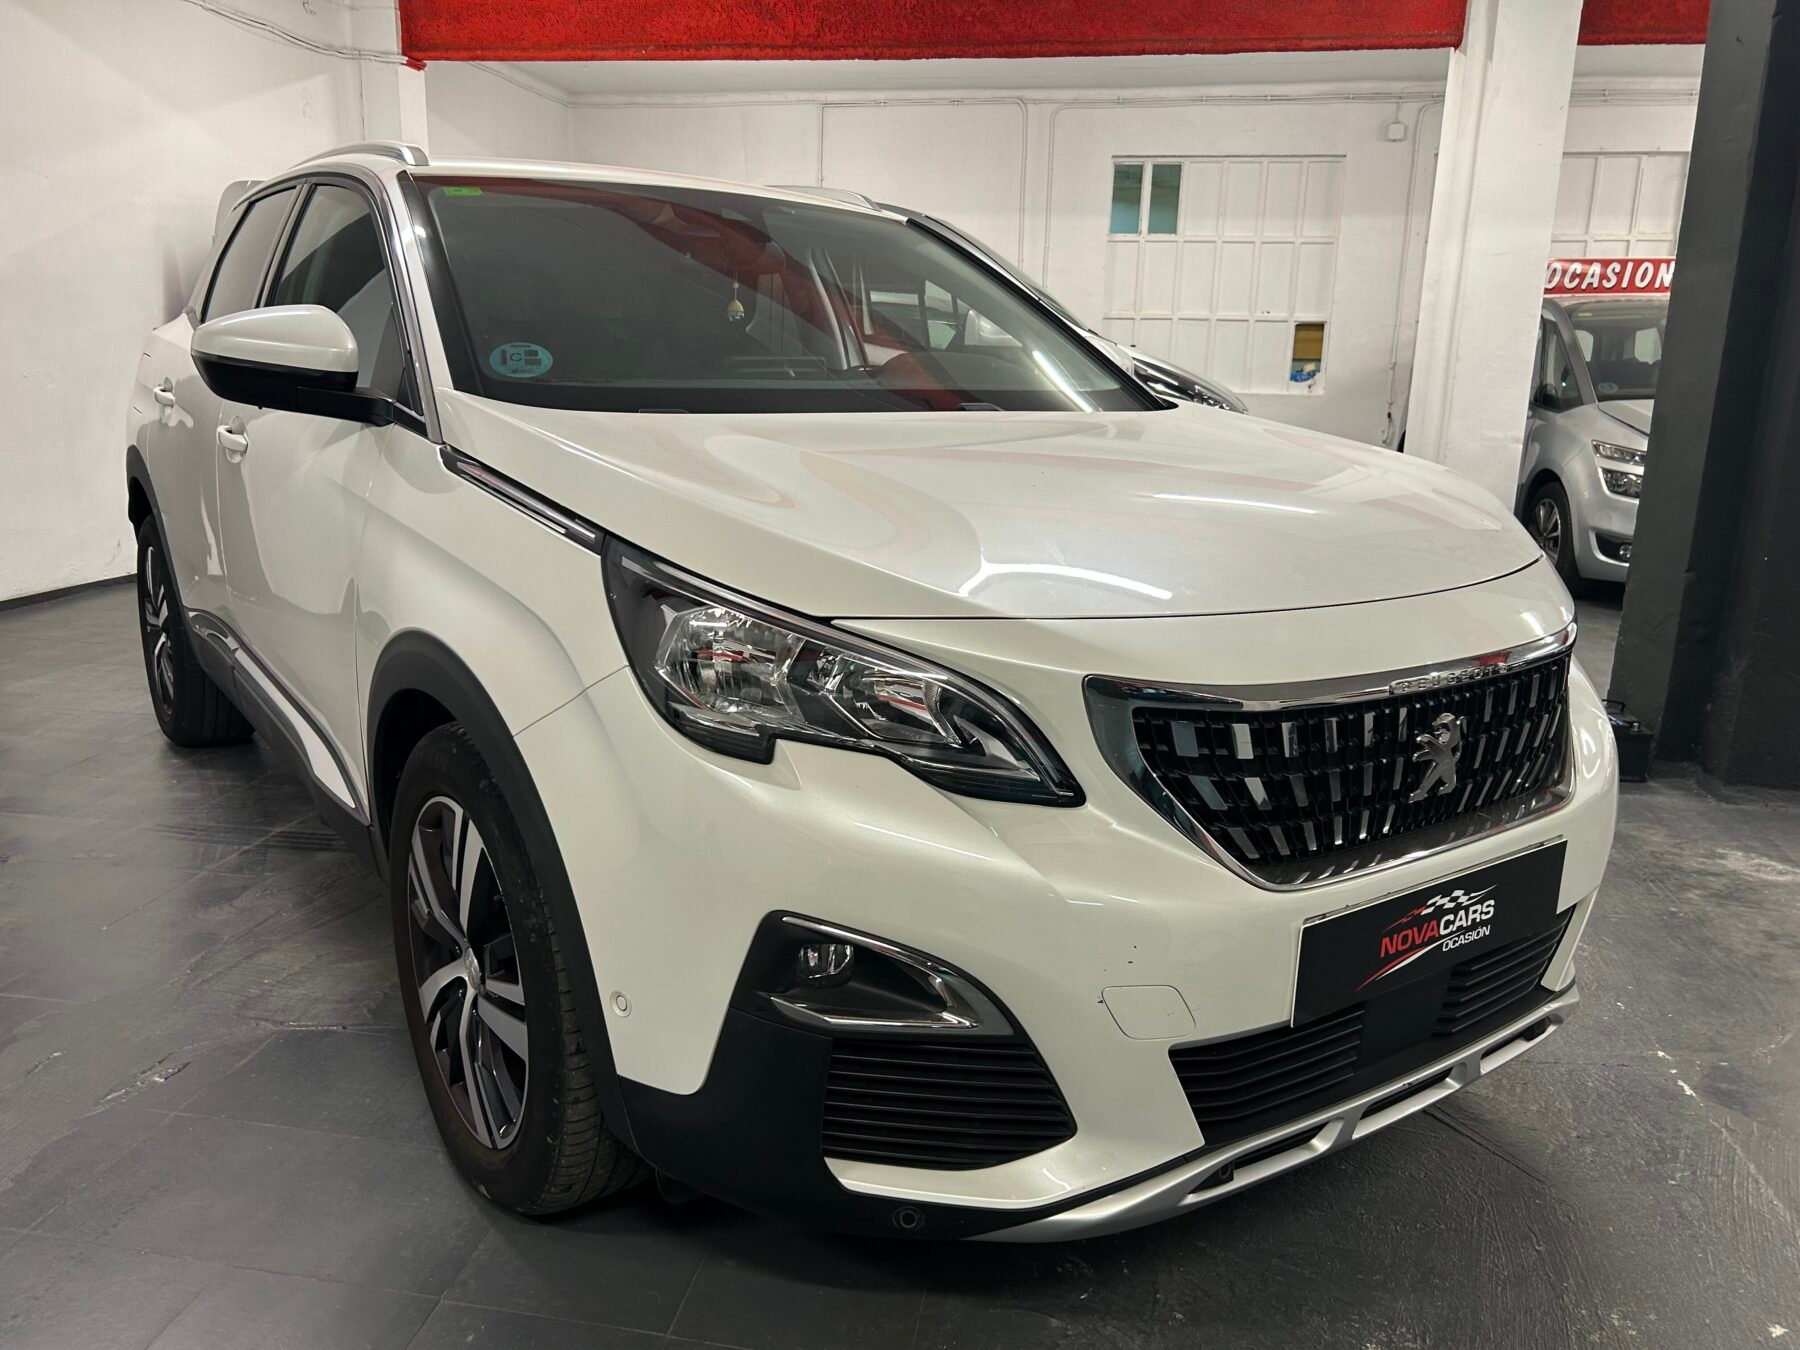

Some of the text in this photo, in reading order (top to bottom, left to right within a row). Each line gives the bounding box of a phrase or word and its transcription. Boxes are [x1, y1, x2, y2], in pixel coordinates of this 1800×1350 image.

[1544, 261, 1676, 290] OCASION
[1400, 666, 1496, 693] PEUGEOT
[1442, 924, 1491, 951] OCASIÓN
